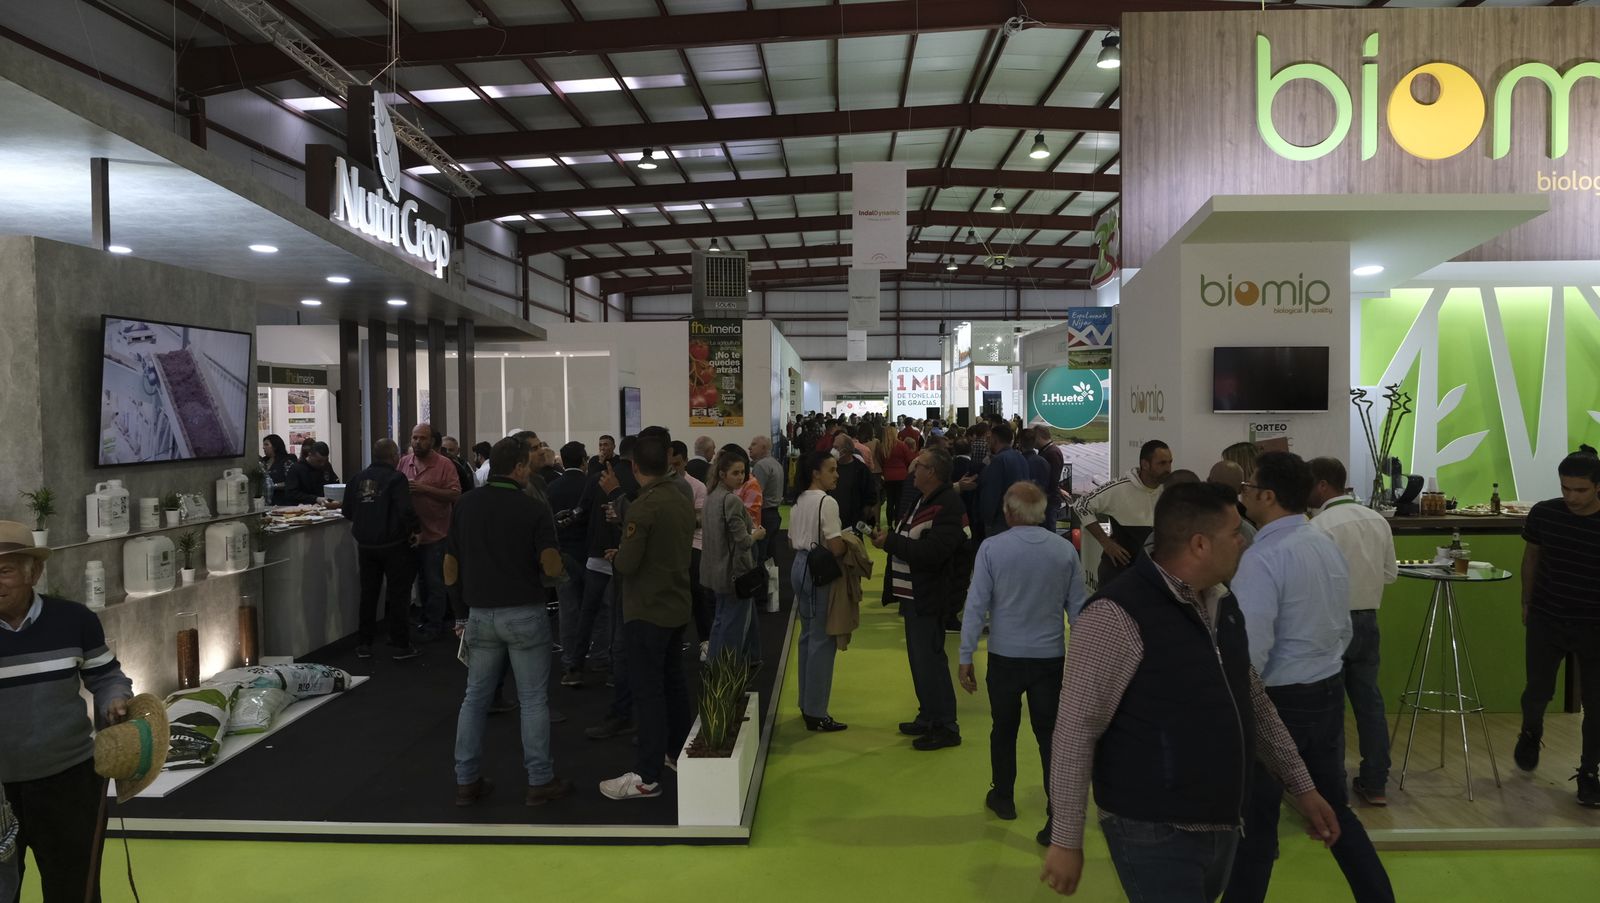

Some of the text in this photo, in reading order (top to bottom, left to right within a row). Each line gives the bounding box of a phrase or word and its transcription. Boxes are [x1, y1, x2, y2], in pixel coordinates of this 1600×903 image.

[334, 156, 450, 279] NutriCrop
[1200, 272, 1330, 313] biomip
[708, 359, 740, 367] quedes
[896, 374, 907, 391] 1
[1041, 393, 1084, 403] J.Huete
[1130, 384, 1164, 418] biomip
